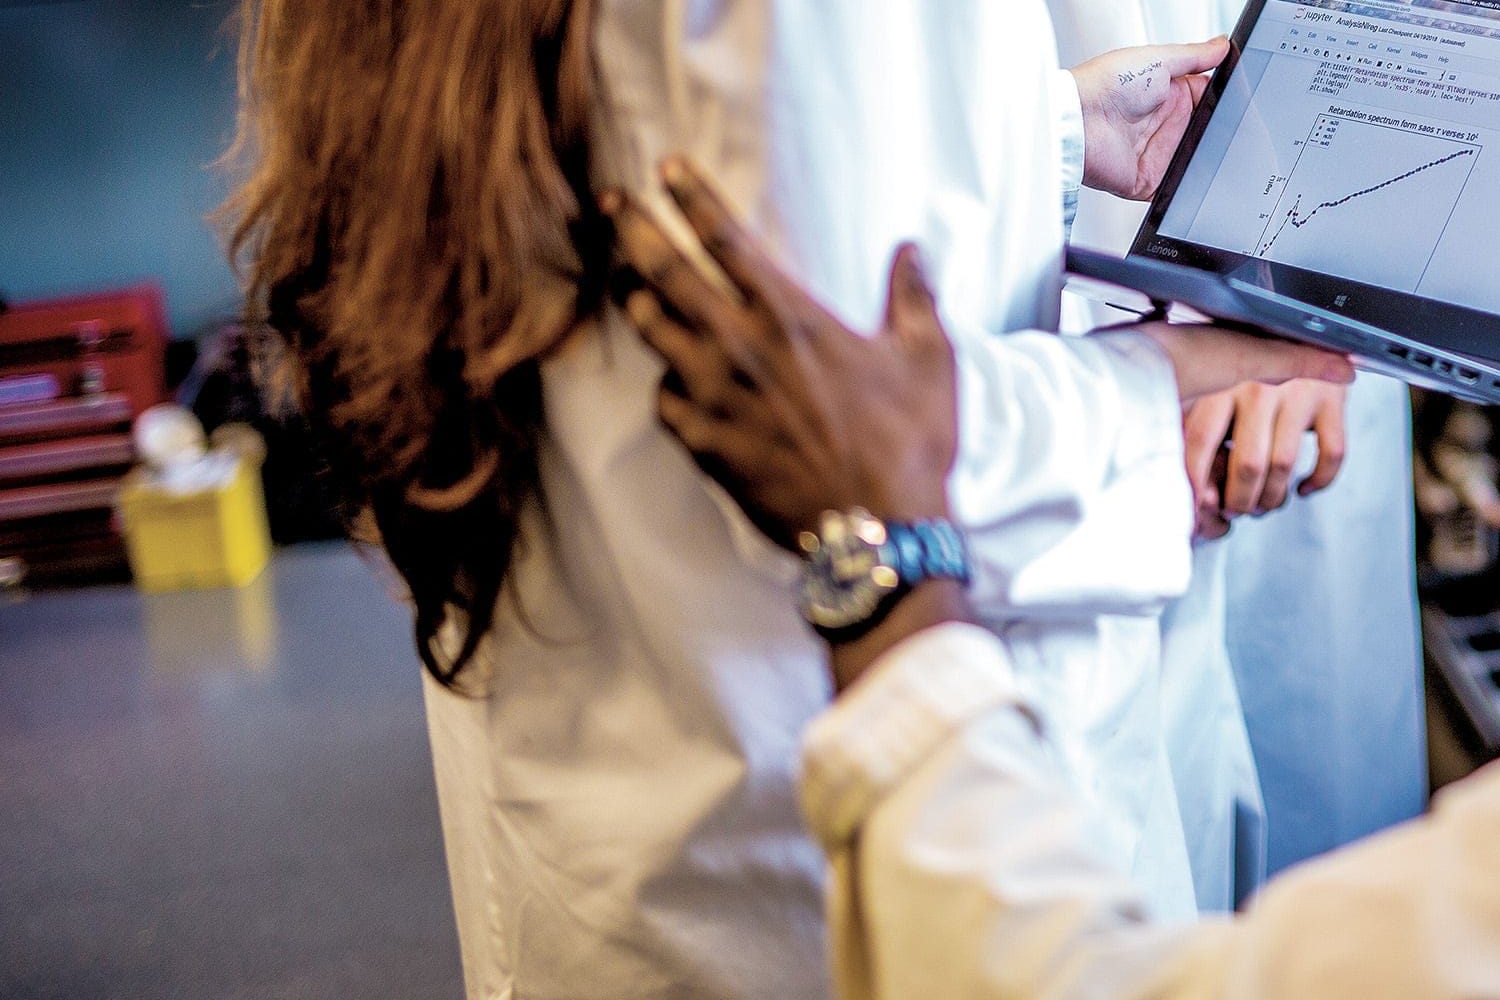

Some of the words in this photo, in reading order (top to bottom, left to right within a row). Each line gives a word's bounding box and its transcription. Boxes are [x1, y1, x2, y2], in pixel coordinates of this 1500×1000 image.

[1304, 10, 1333, 22] jupyter
[1378, 26, 1389, 34] Last
[1290, 28, 1299, 36] File
[1386, 46, 1401, 55] Kernel
[1410, 50, 1428, 60] Widgets
[1438, 55, 1449, 64] Help
[1309, 84, 1340, 96] plt.show()
[1312, 77, 1350, 90] plt.loglog()
[1389, 74, 1416, 85] spectrum
[1416, 79, 1430, 87] form
[1468, 89, 1487, 98] verses
[1328, 105, 1367, 120] Retardation
[1367, 114, 1400, 127] spectrum
[1400, 119, 1417, 130] form
[1418, 124, 1434, 133] saos
[1442, 129, 1465, 139] verses
[1146, 241, 1178, 258] Lenovo
